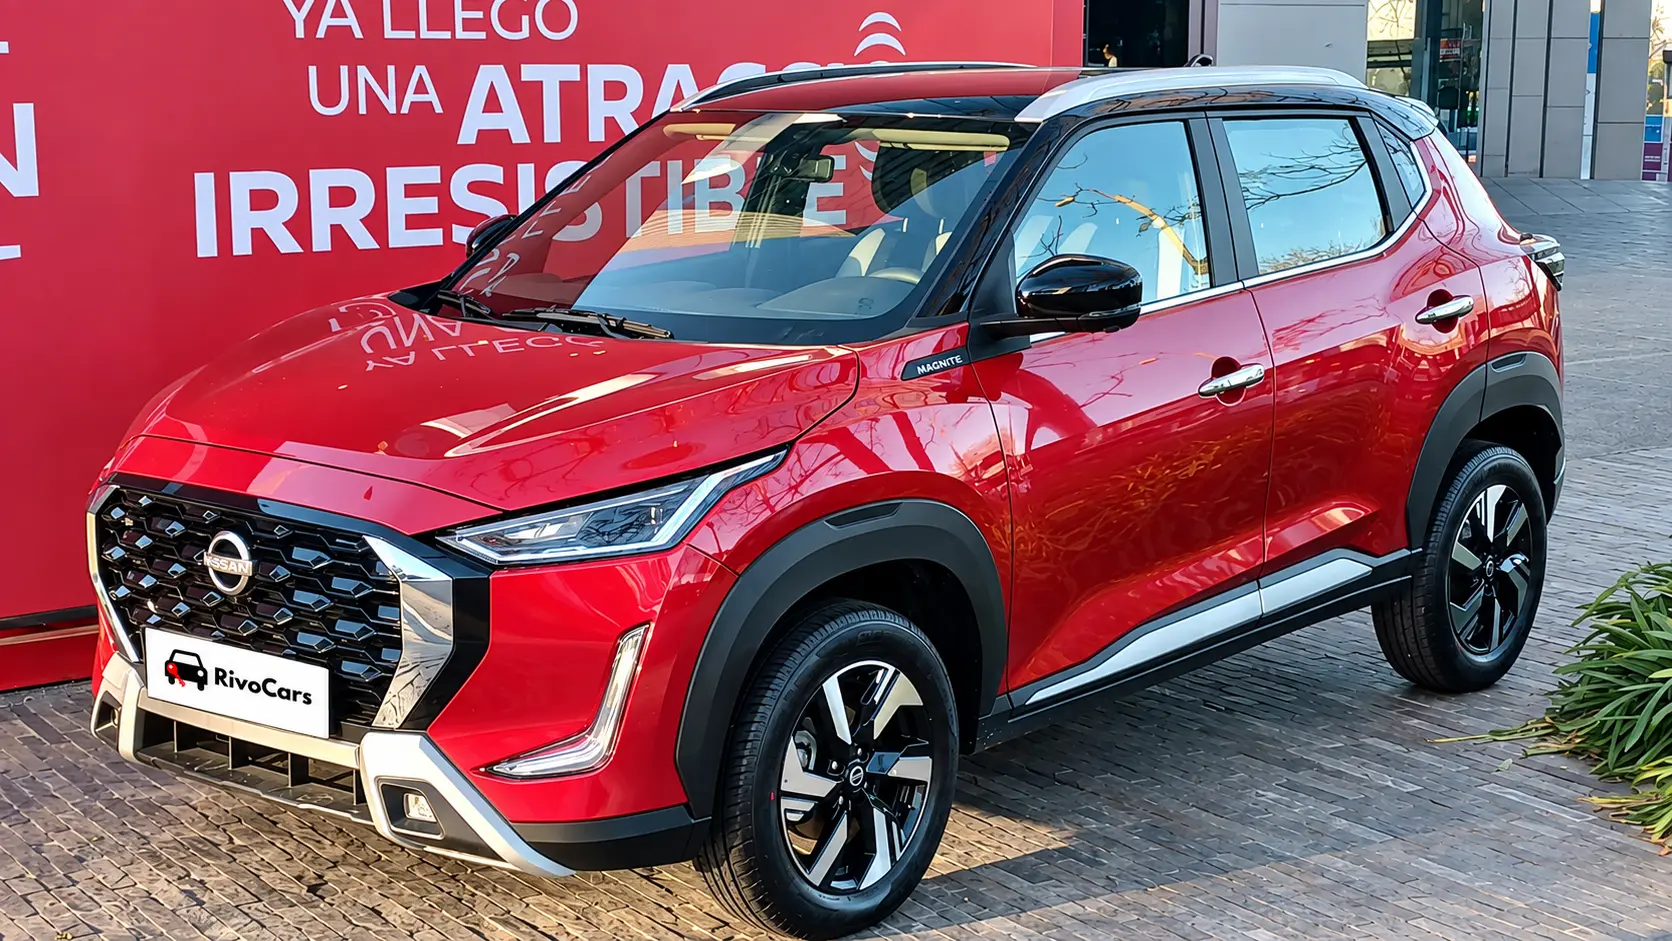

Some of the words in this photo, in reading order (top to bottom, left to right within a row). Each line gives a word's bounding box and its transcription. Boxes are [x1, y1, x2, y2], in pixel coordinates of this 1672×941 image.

[282, 0, 364, 39] YA
[382, 0, 579, 40] LLEGO
[308, 65, 443, 116] UNA
[194, 154, 847, 258] IRRESISTIBE
[916, 355, 963, 375] MAGNITE
[214, 667, 312, 705] RivoCars
